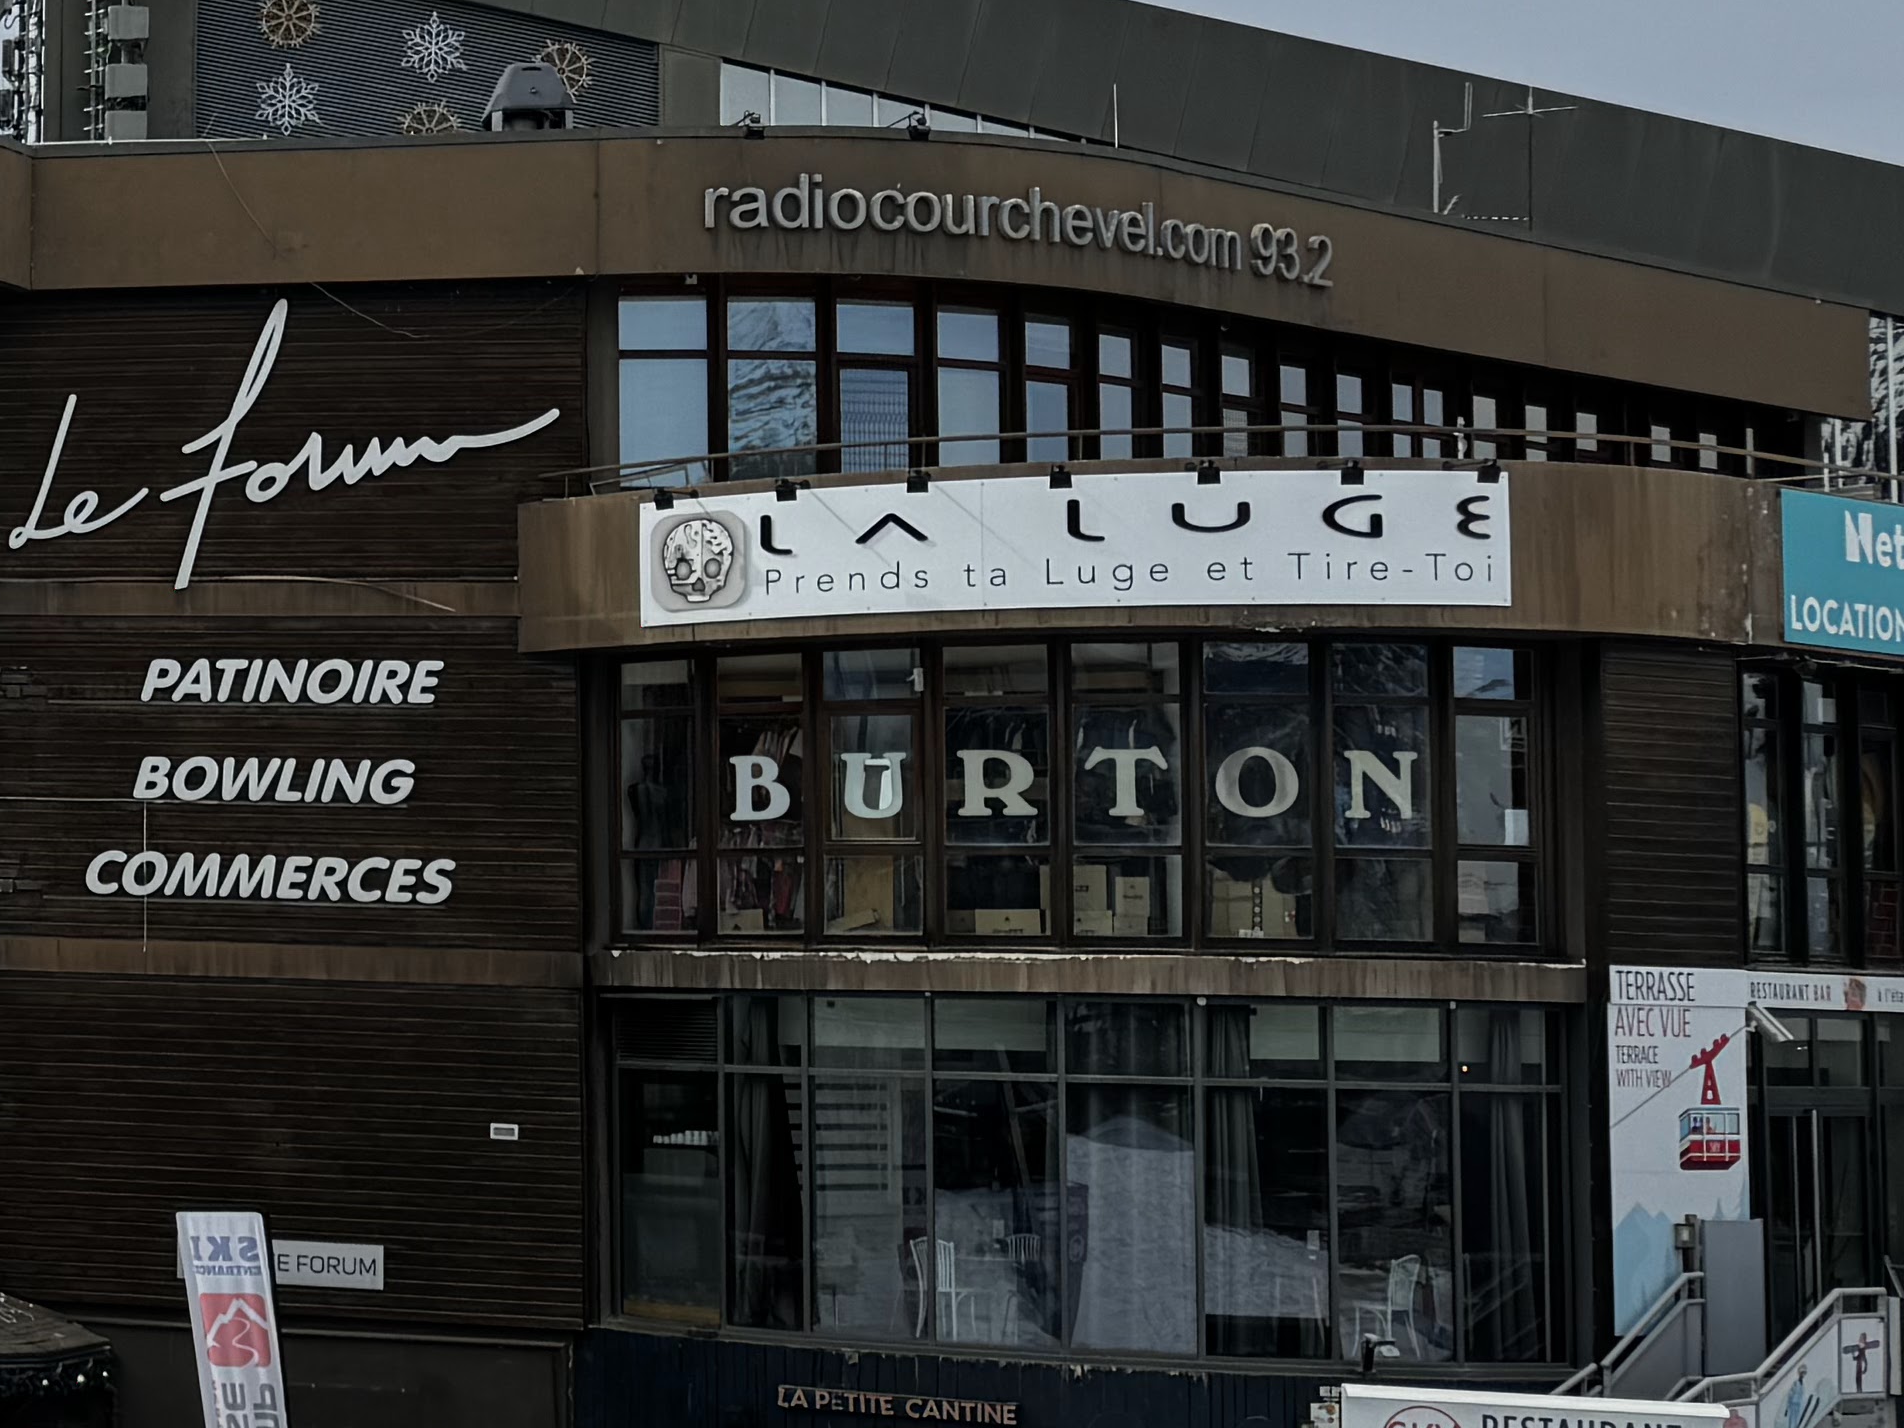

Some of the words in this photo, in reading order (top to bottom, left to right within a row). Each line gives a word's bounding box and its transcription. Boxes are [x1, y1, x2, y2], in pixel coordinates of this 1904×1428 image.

[703, 173, 1242, 271] radiocourchevel.com
[1250, 223, 1334, 288] 93.2
[7, 393, 149, 550] Le
[759, 512, 930, 556] LA
[1066, 493, 1492, 542] LUGE
[765, 563, 930, 596] Prends
[964, 564, 1008, 589] ta
[1044, 558, 1170, 592] Luge
[1206, 555, 1255, 581] et
[1288, 552, 1494, 585] Tire-Toi
[139, 657, 445, 706] PATINOIRE
[132, 755, 416, 805] BOWLING
[728, 745, 1419, 821] BURTON
[84, 849, 456, 905] COMMERCES
[1615, 970, 1696, 1003] TERRASSE
[1750, 981, 1810, 1002] RESTAURANT
[1814, 983, 1832, 1002] BAR
[1614, 1007, 1656, 1038] AVEC
[1659, 1007, 1692, 1038] VUE
[1615, 1045, 1659, 1065] TERRACE
[1616, 1068, 1642, 1088] WITH
[1645, 1069, 1672, 1089] VIEW
[297, 1254, 377, 1276] FORUM
[777, 1387, 809, 1409] LA
[815, 1390, 895, 1416] PETITE
[905, 1398, 1018, 1426] CANTINE
